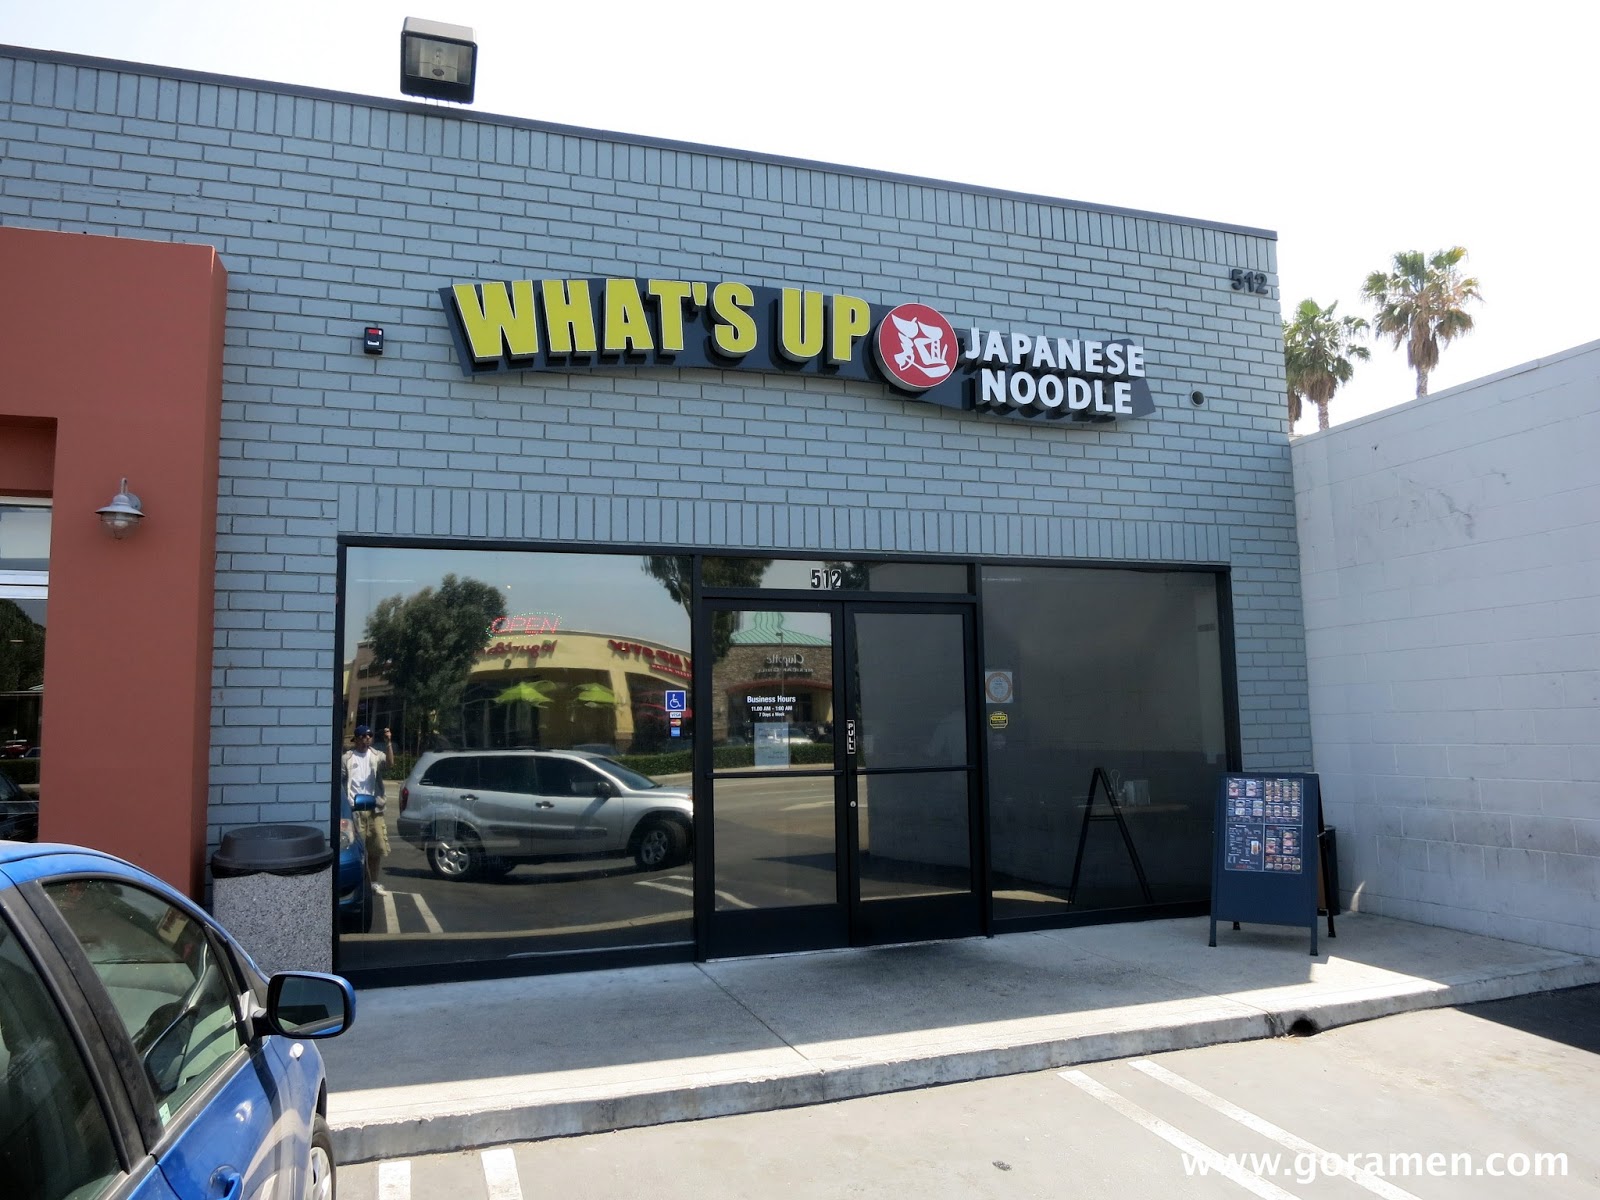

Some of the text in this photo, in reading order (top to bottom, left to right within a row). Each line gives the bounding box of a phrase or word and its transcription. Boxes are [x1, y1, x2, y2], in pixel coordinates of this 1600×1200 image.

[1231, 268, 1269, 295] 512
[452, 278, 871, 363] WHAT'S UP
[964, 326, 1146, 378] JAPANESE
[980, 367, 1133, 415] NOODLE
[811, 567, 841, 590] 512
[490, 615, 560, 635] OPEN
[747, 695, 796, 703] Business Hours
[847, 722, 855, 752] PULL
